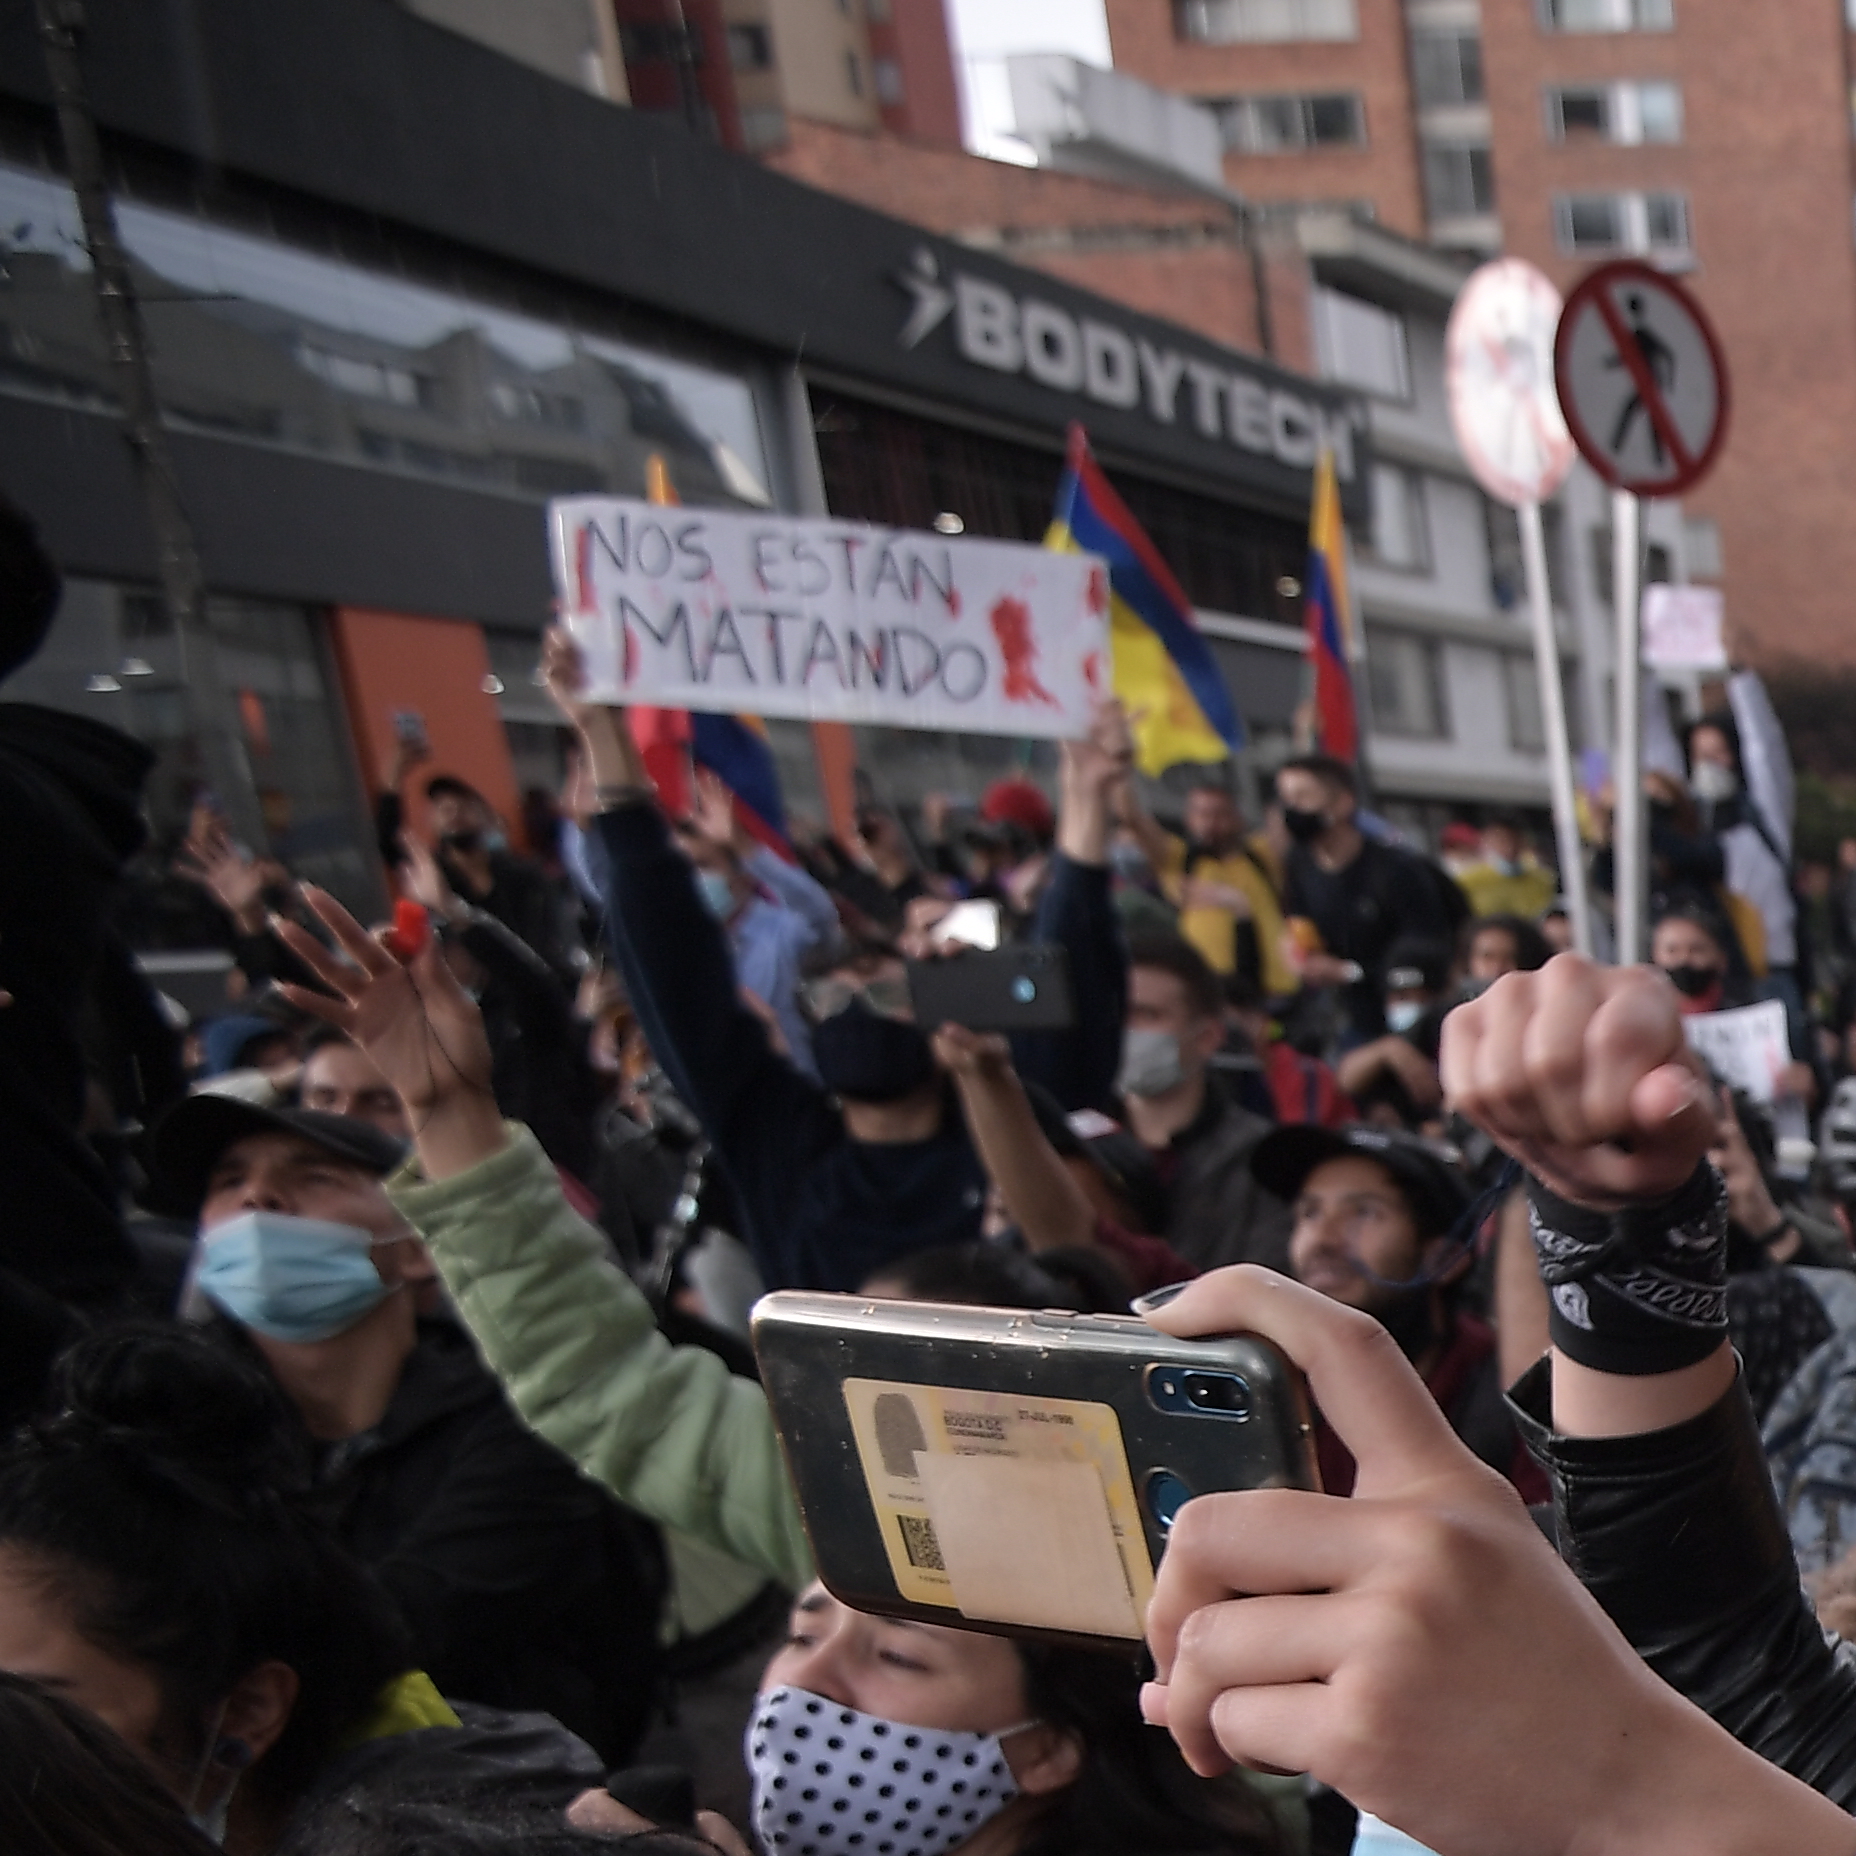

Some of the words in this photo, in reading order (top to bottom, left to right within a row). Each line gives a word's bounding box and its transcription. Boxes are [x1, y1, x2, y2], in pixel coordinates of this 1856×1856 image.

[956, 274, 1356, 482] BODYTECH
[586, 514, 712, 582] NOS
[618, 595, 987, 702] MATANDO
